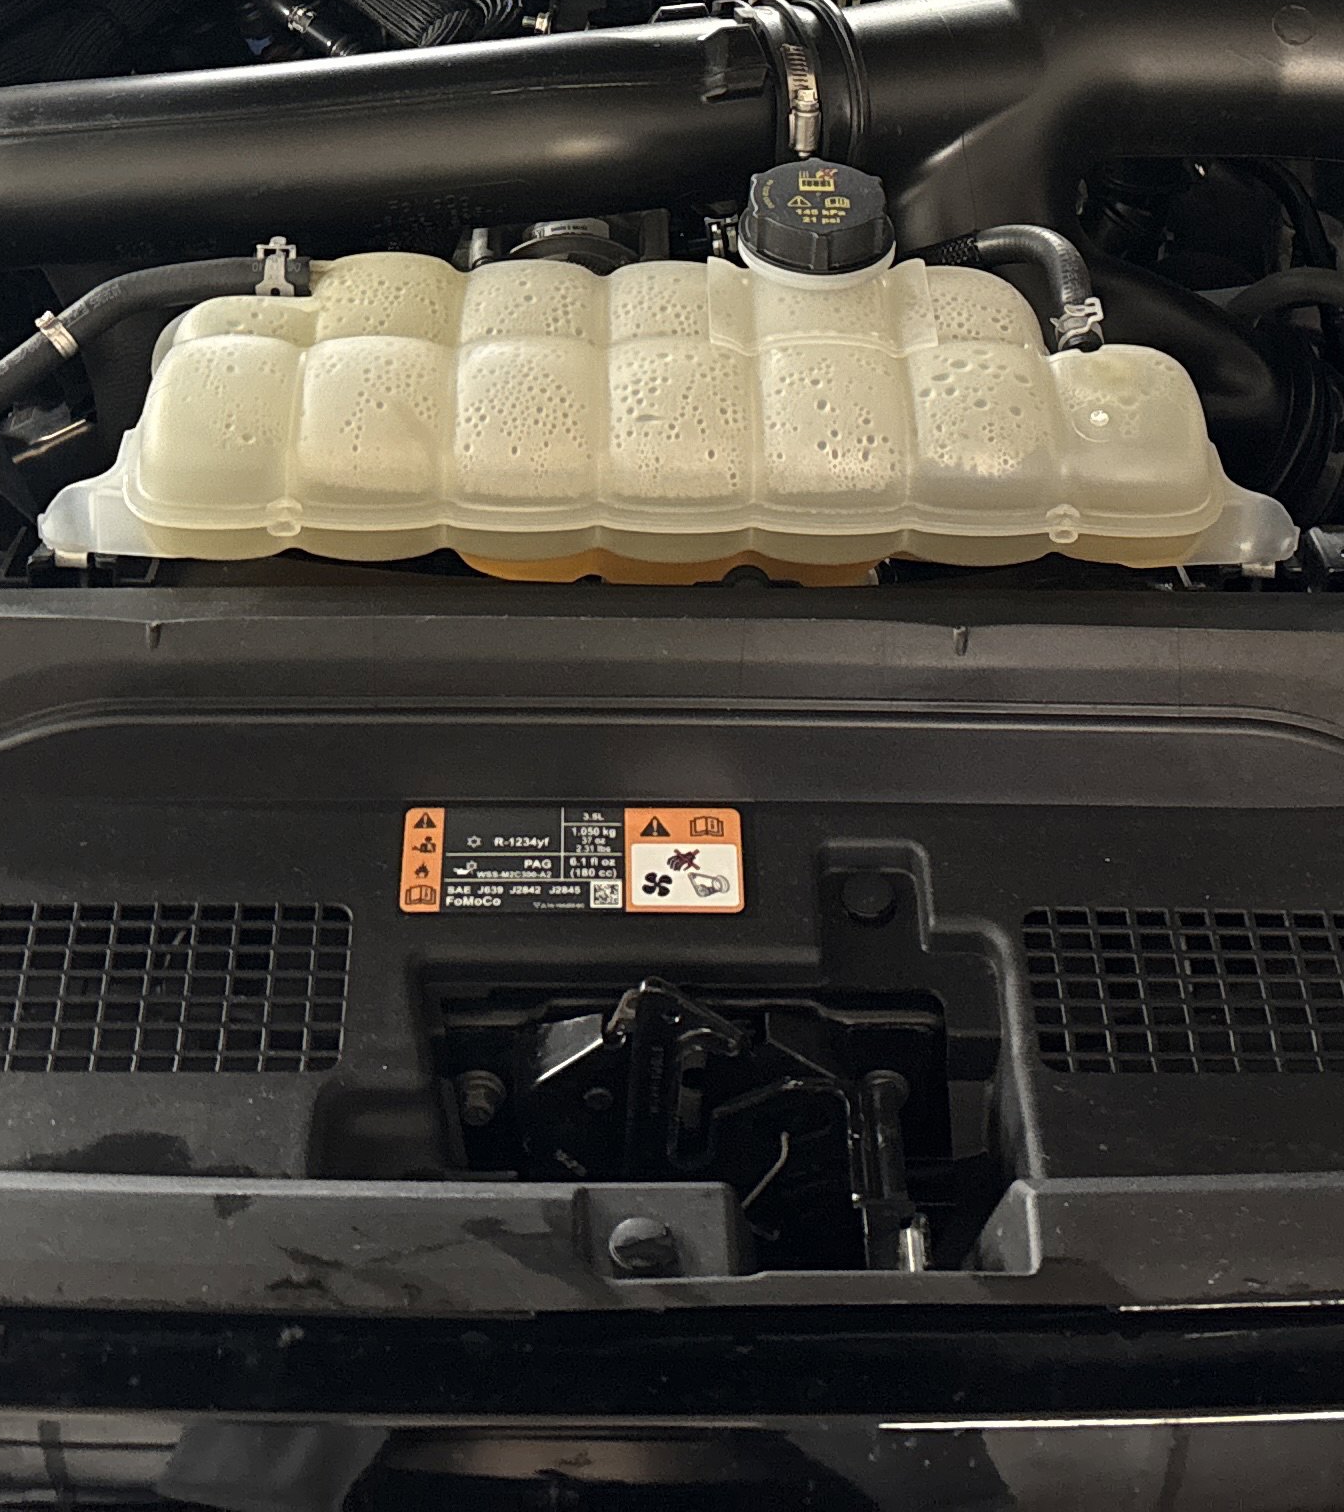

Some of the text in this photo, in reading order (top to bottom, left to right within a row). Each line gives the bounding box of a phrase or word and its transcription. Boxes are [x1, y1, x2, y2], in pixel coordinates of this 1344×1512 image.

[822, 208, 847, 216] kPa
[802, 216, 841, 224] 21 psi
[572, 827, 617, 838] 1.050 kg
[494, 836, 550, 849] R-1234yf
[582, 836, 593, 845] 37
[597, 845, 611, 853] lbs
[524, 858, 552, 869] PAG
[570, 857, 617, 867] 6.1 fl oz
[570, 868, 618, 879] (180 cc)
[446, 885, 582, 895] SAE J639 J2842 J2845
[445, 895, 502, 908] FoMoCo
